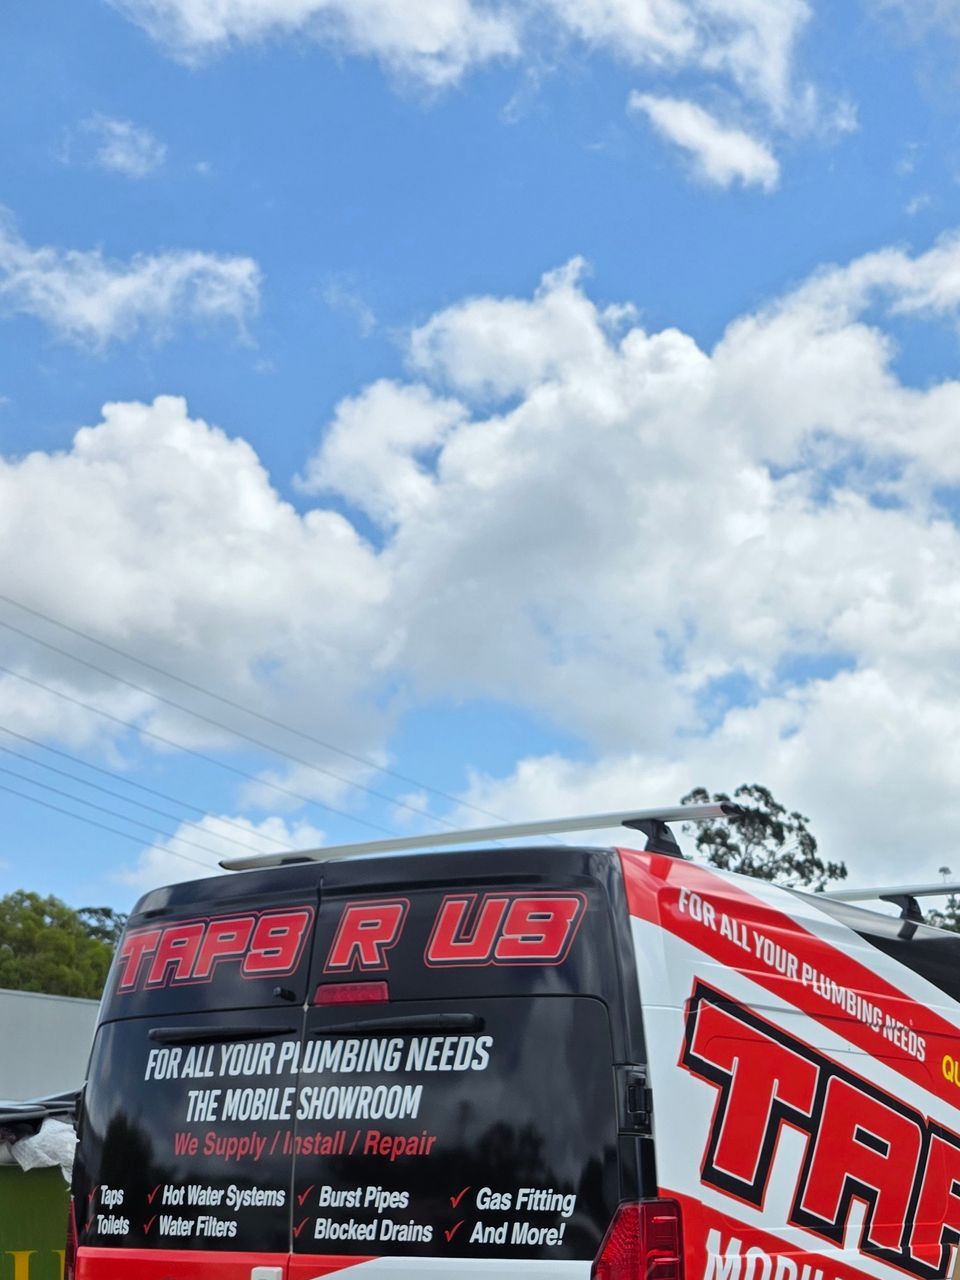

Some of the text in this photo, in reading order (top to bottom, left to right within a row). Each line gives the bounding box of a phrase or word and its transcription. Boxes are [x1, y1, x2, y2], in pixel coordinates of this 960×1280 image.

[116, 891, 588, 995] TAPS R US
[678, 887, 926, 1062] FOR ALL YOUR PLUMBING NEEDS
[145, 1035, 494, 1080] FOR ALL YOUR PLUMBING NEEDS
[186, 1084, 423, 1122] THE MOBILE SHOWROOM
[174, 1131, 199, 1157] We
[202, 1130, 268, 1161] Supply
[282, 1130, 347, 1156] Install
[364, 1129, 436, 1162] Repair
[100, 1185, 124, 1209] Taps
[162, 1184, 286, 1211] Hot Water Systems
[319, 1185, 410, 1213] Burst Pipes
[476, 1187, 577, 1217] Gas Fitting
[97, 1214, 130, 1235] Toilets
[159, 1215, 238, 1237] Water Filters
[314, 1218, 433, 1242] Blocked Drains
[469, 1221, 566, 1245] And More!
